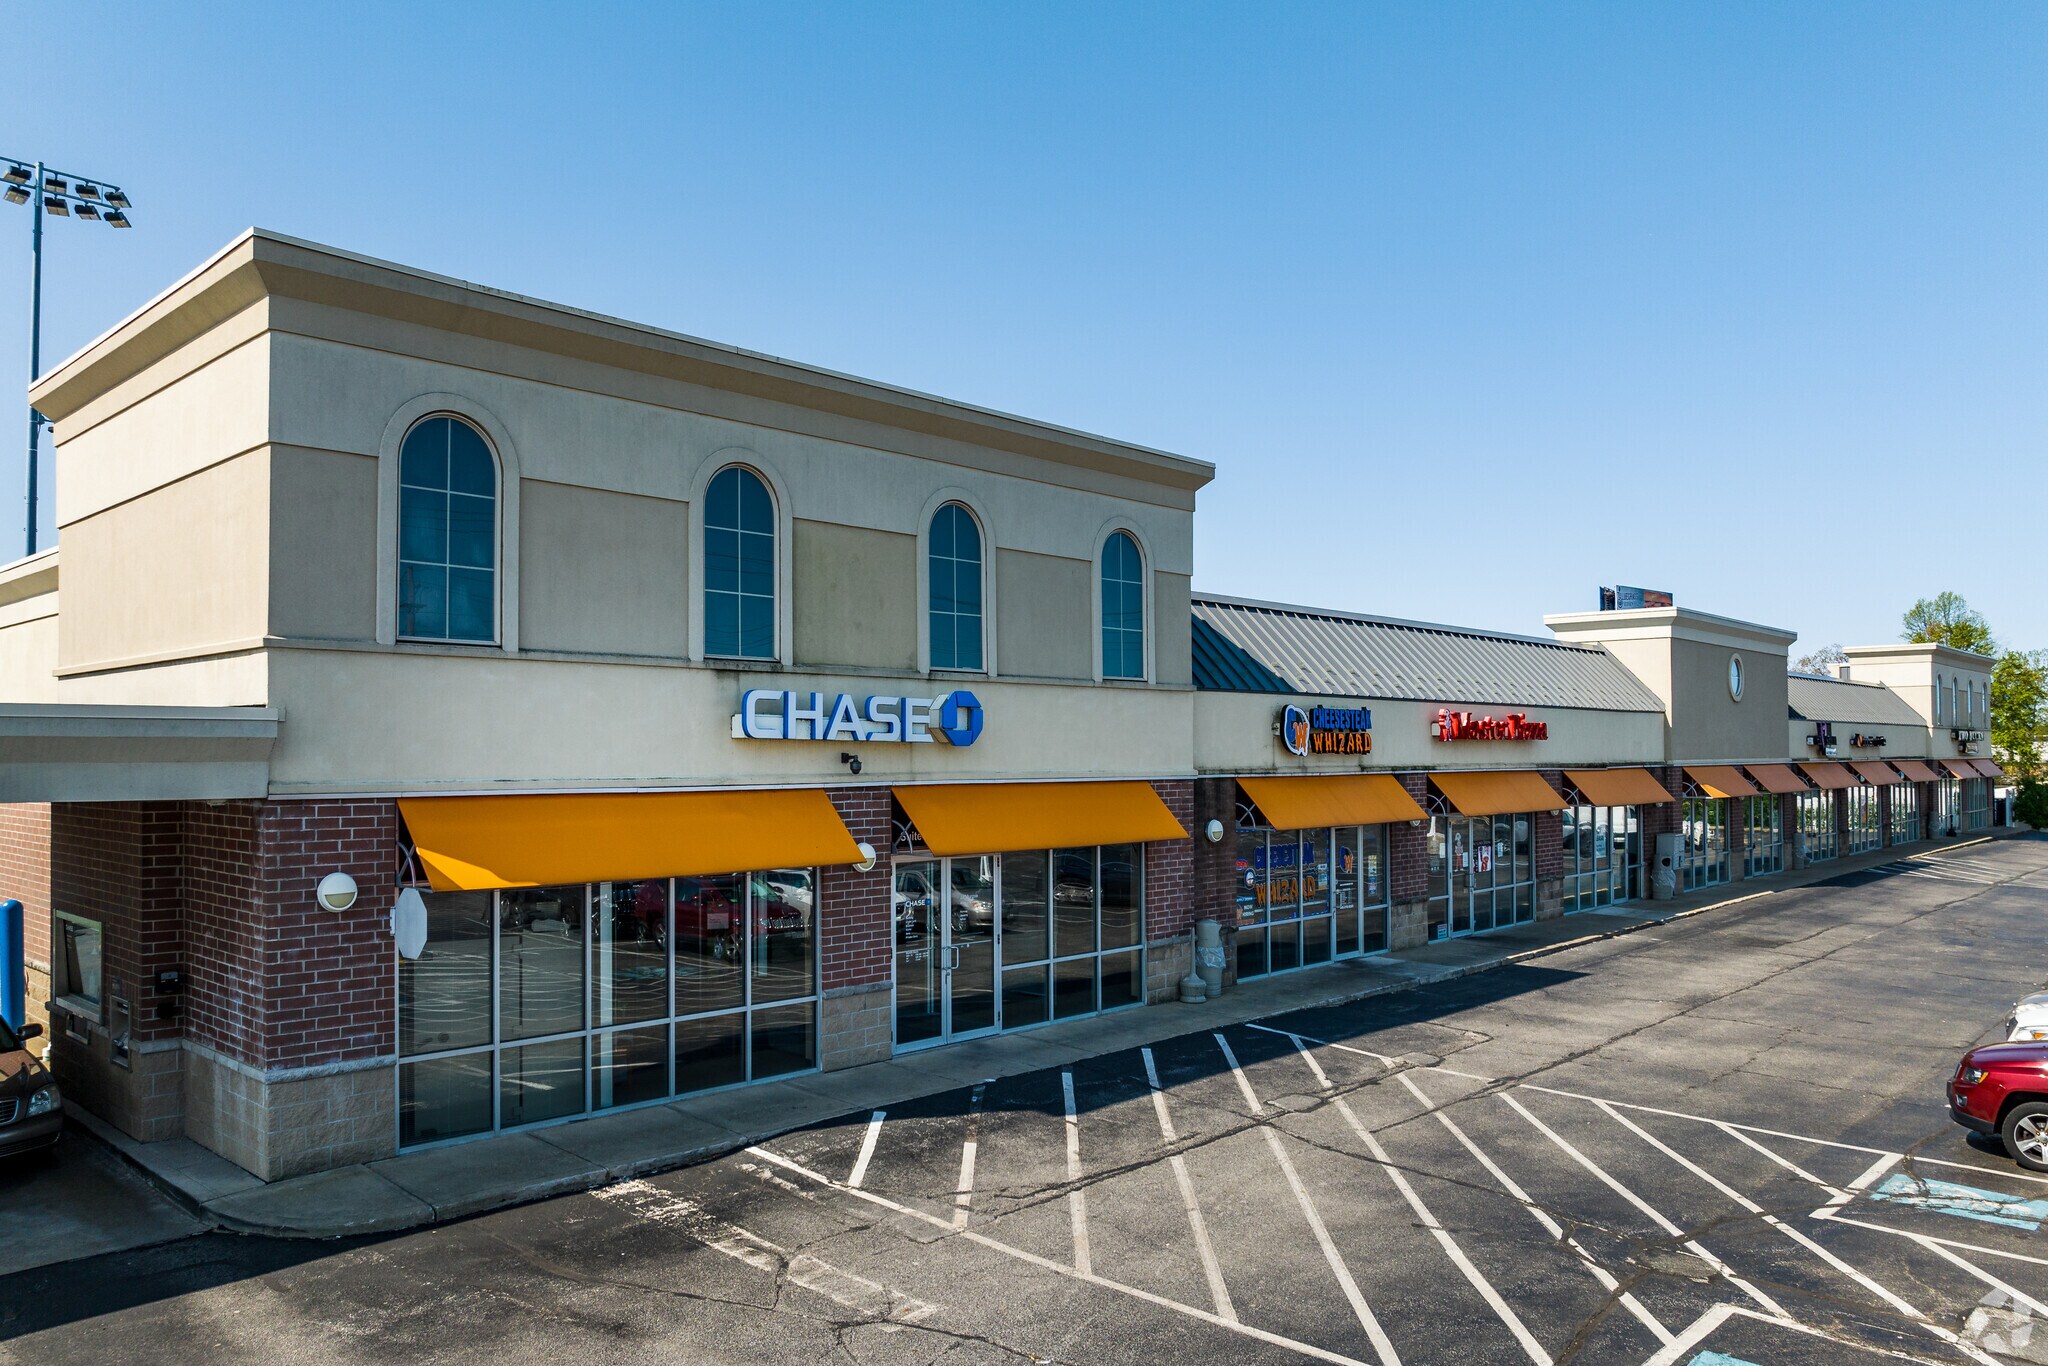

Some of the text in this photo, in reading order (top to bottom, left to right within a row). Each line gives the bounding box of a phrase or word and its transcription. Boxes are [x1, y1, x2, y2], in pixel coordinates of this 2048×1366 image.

[742, 689, 934, 743] CHASE
[1311, 707, 1372, 730] CHEESESTEAK
[1312, 732, 1372, 753] WHIZARD
[905, 900, 926, 908] CHASE
